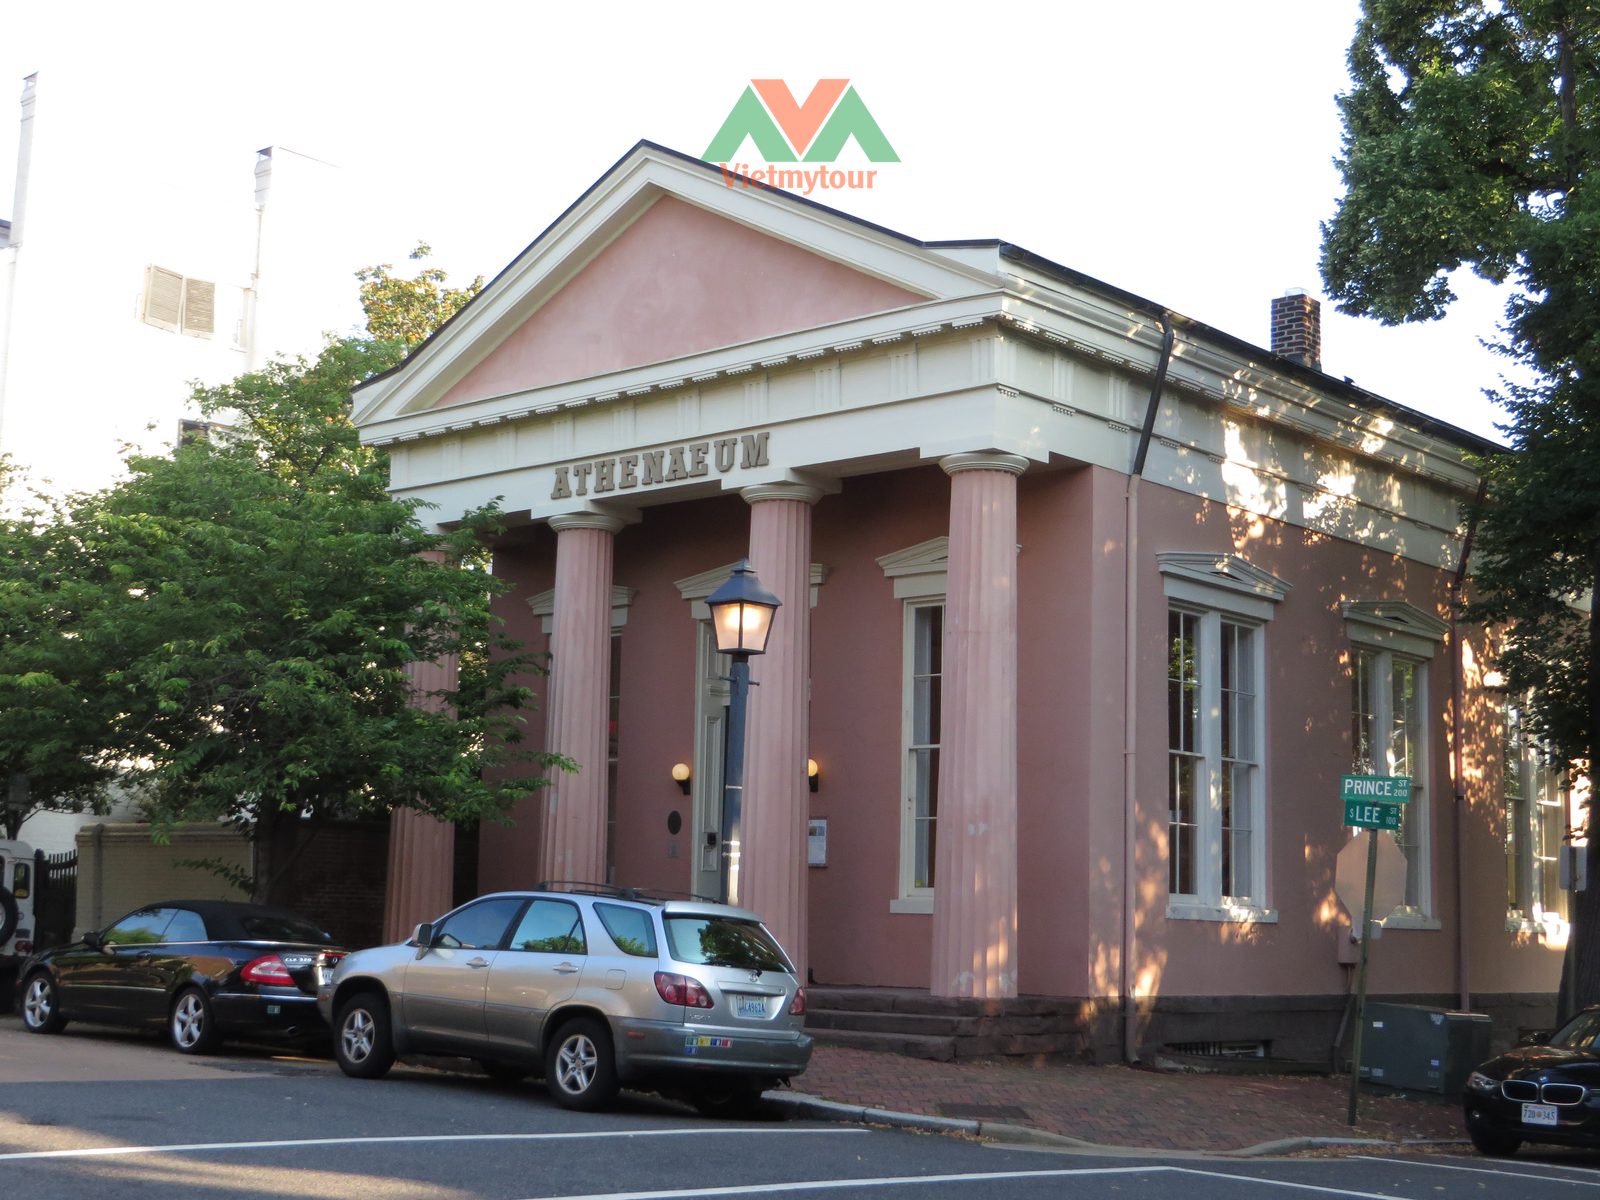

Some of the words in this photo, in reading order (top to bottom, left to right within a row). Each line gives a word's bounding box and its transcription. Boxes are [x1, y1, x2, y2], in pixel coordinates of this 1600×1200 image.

[551, 432, 770, 499] ATHENAEUM
[1345, 779, 1392, 796] PRINCE
[1393, 789, 1408, 797] 200
[1349, 808, 1354, 818] S
[1356, 805, 1381, 823] LEE
[1390, 807, 1397, 815] ST
